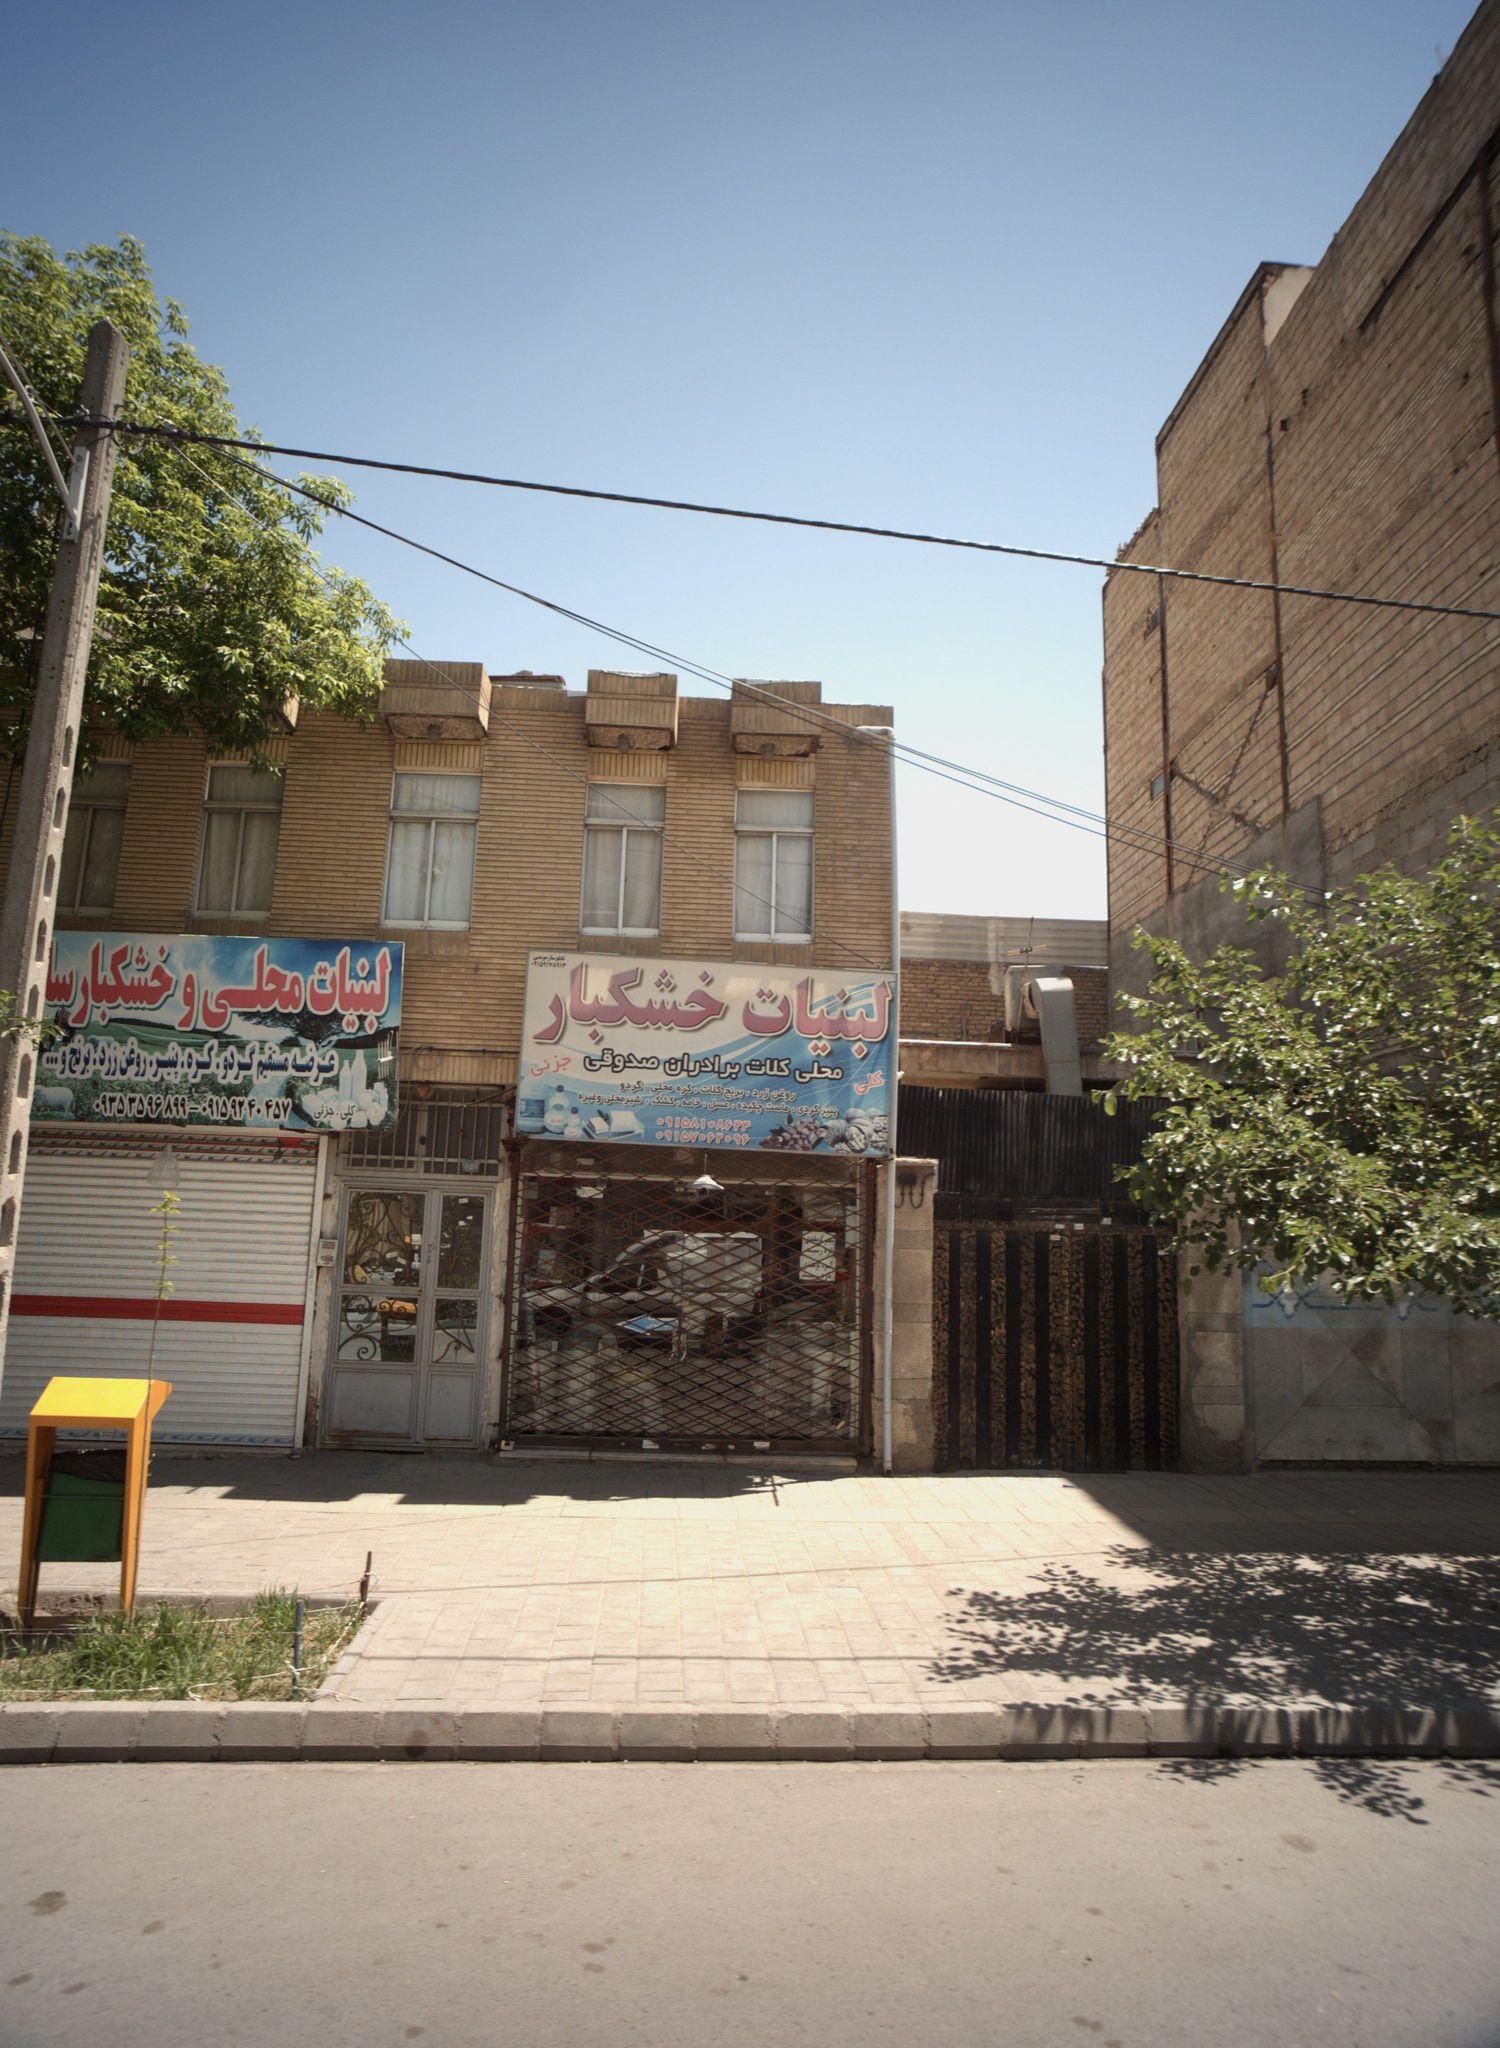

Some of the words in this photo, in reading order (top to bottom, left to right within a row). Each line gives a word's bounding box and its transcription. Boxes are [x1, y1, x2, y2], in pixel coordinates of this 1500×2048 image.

[69, 939, 175, 1028] خشکبار
[175, 970, 197, 1031] و
[202, 944, 304, 1029] محلی
[307, 946, 391, 1034] لبنیات
[532, 961, 727, 1045] خشکبار
[742, 975, 893, 1058] لبنیات
[254, 1039, 290, 1084] مستقیم
[583, 1048, 660, 1073] صدوقی
[664, 1053, 740, 1079] برادران
[745, 1057, 791, 1078] کلات
[794, 1059, 844, 1084] محلی
[853, 1070, 886, 1095] کلی
